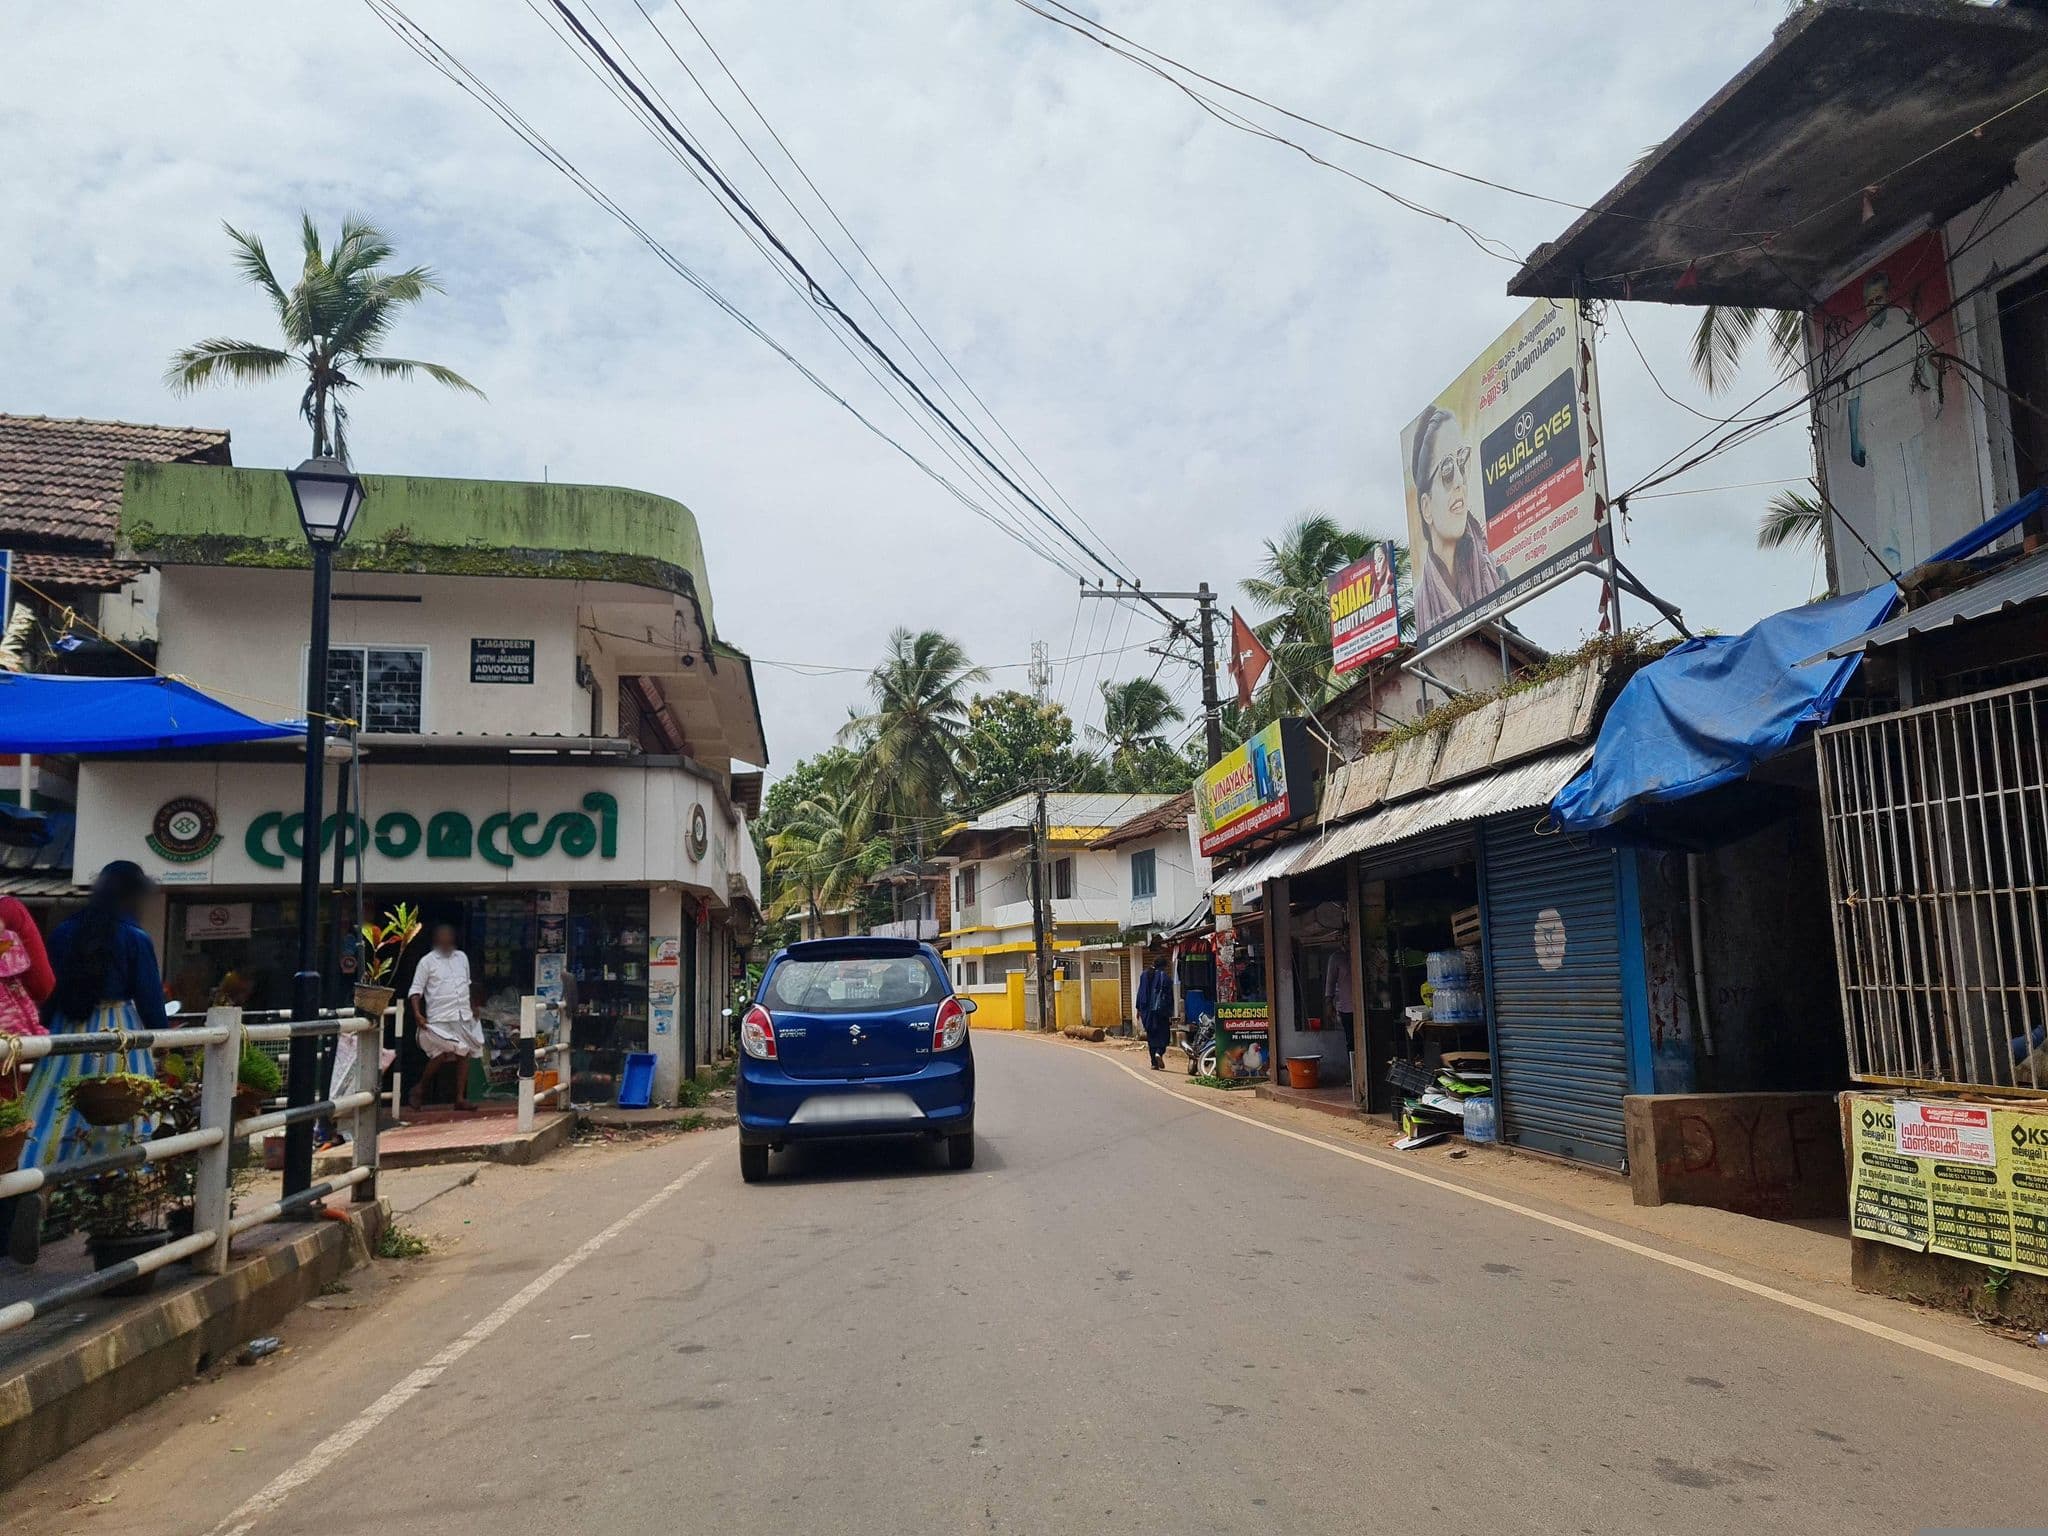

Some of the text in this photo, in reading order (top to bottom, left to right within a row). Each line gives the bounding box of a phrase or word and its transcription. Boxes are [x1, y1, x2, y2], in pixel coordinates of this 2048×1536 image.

[1485, 404, 1572, 485] VISUAL EYES
[1541, 565, 1554, 580] WEAR
[1556, 551, 1579, 572] DESIGNER
[1330, 574, 1373, 622] SHAAZ
[1333, 613, 1360, 638] BEAUTY
[1360, 594, 1393, 627] PARLOUR
[475, 664, 529, 674] ADVOCATES
[1212, 761, 1254, 802] VINAYAKA
[1902, 1122, 1959, 1140] പ്രവർത്തന
[1902, 1137, 1960, 1156] ഫണ്ടിലേക്ക്
[1859, 1188, 1878, 1201] 50000
[1909, 1199, 1927, 1213] 37500
[1935, 1205, 1954, 1217] 50000
[1958, 1209, 1965, 1219] 40
[1966, 1211, 1975, 1222] 20
[1987, 1213, 2009, 1225] 37500
[1936, 1220, 1955, 1232] 20000
[1956, 1224, 1966, 1235] 100
[1968, 1226, 1977, 1237] 20
[1990, 1230, 2010, 1241] 15000
[2038, 1220, 2046, 1232] 40
[1969, 1242, 1977, 1253] 10
[1995, 1245, 2011, 1258] 7500
[2035, 1236, 2047, 1249] 100
[2036, 1253, 2048, 1265] 100
